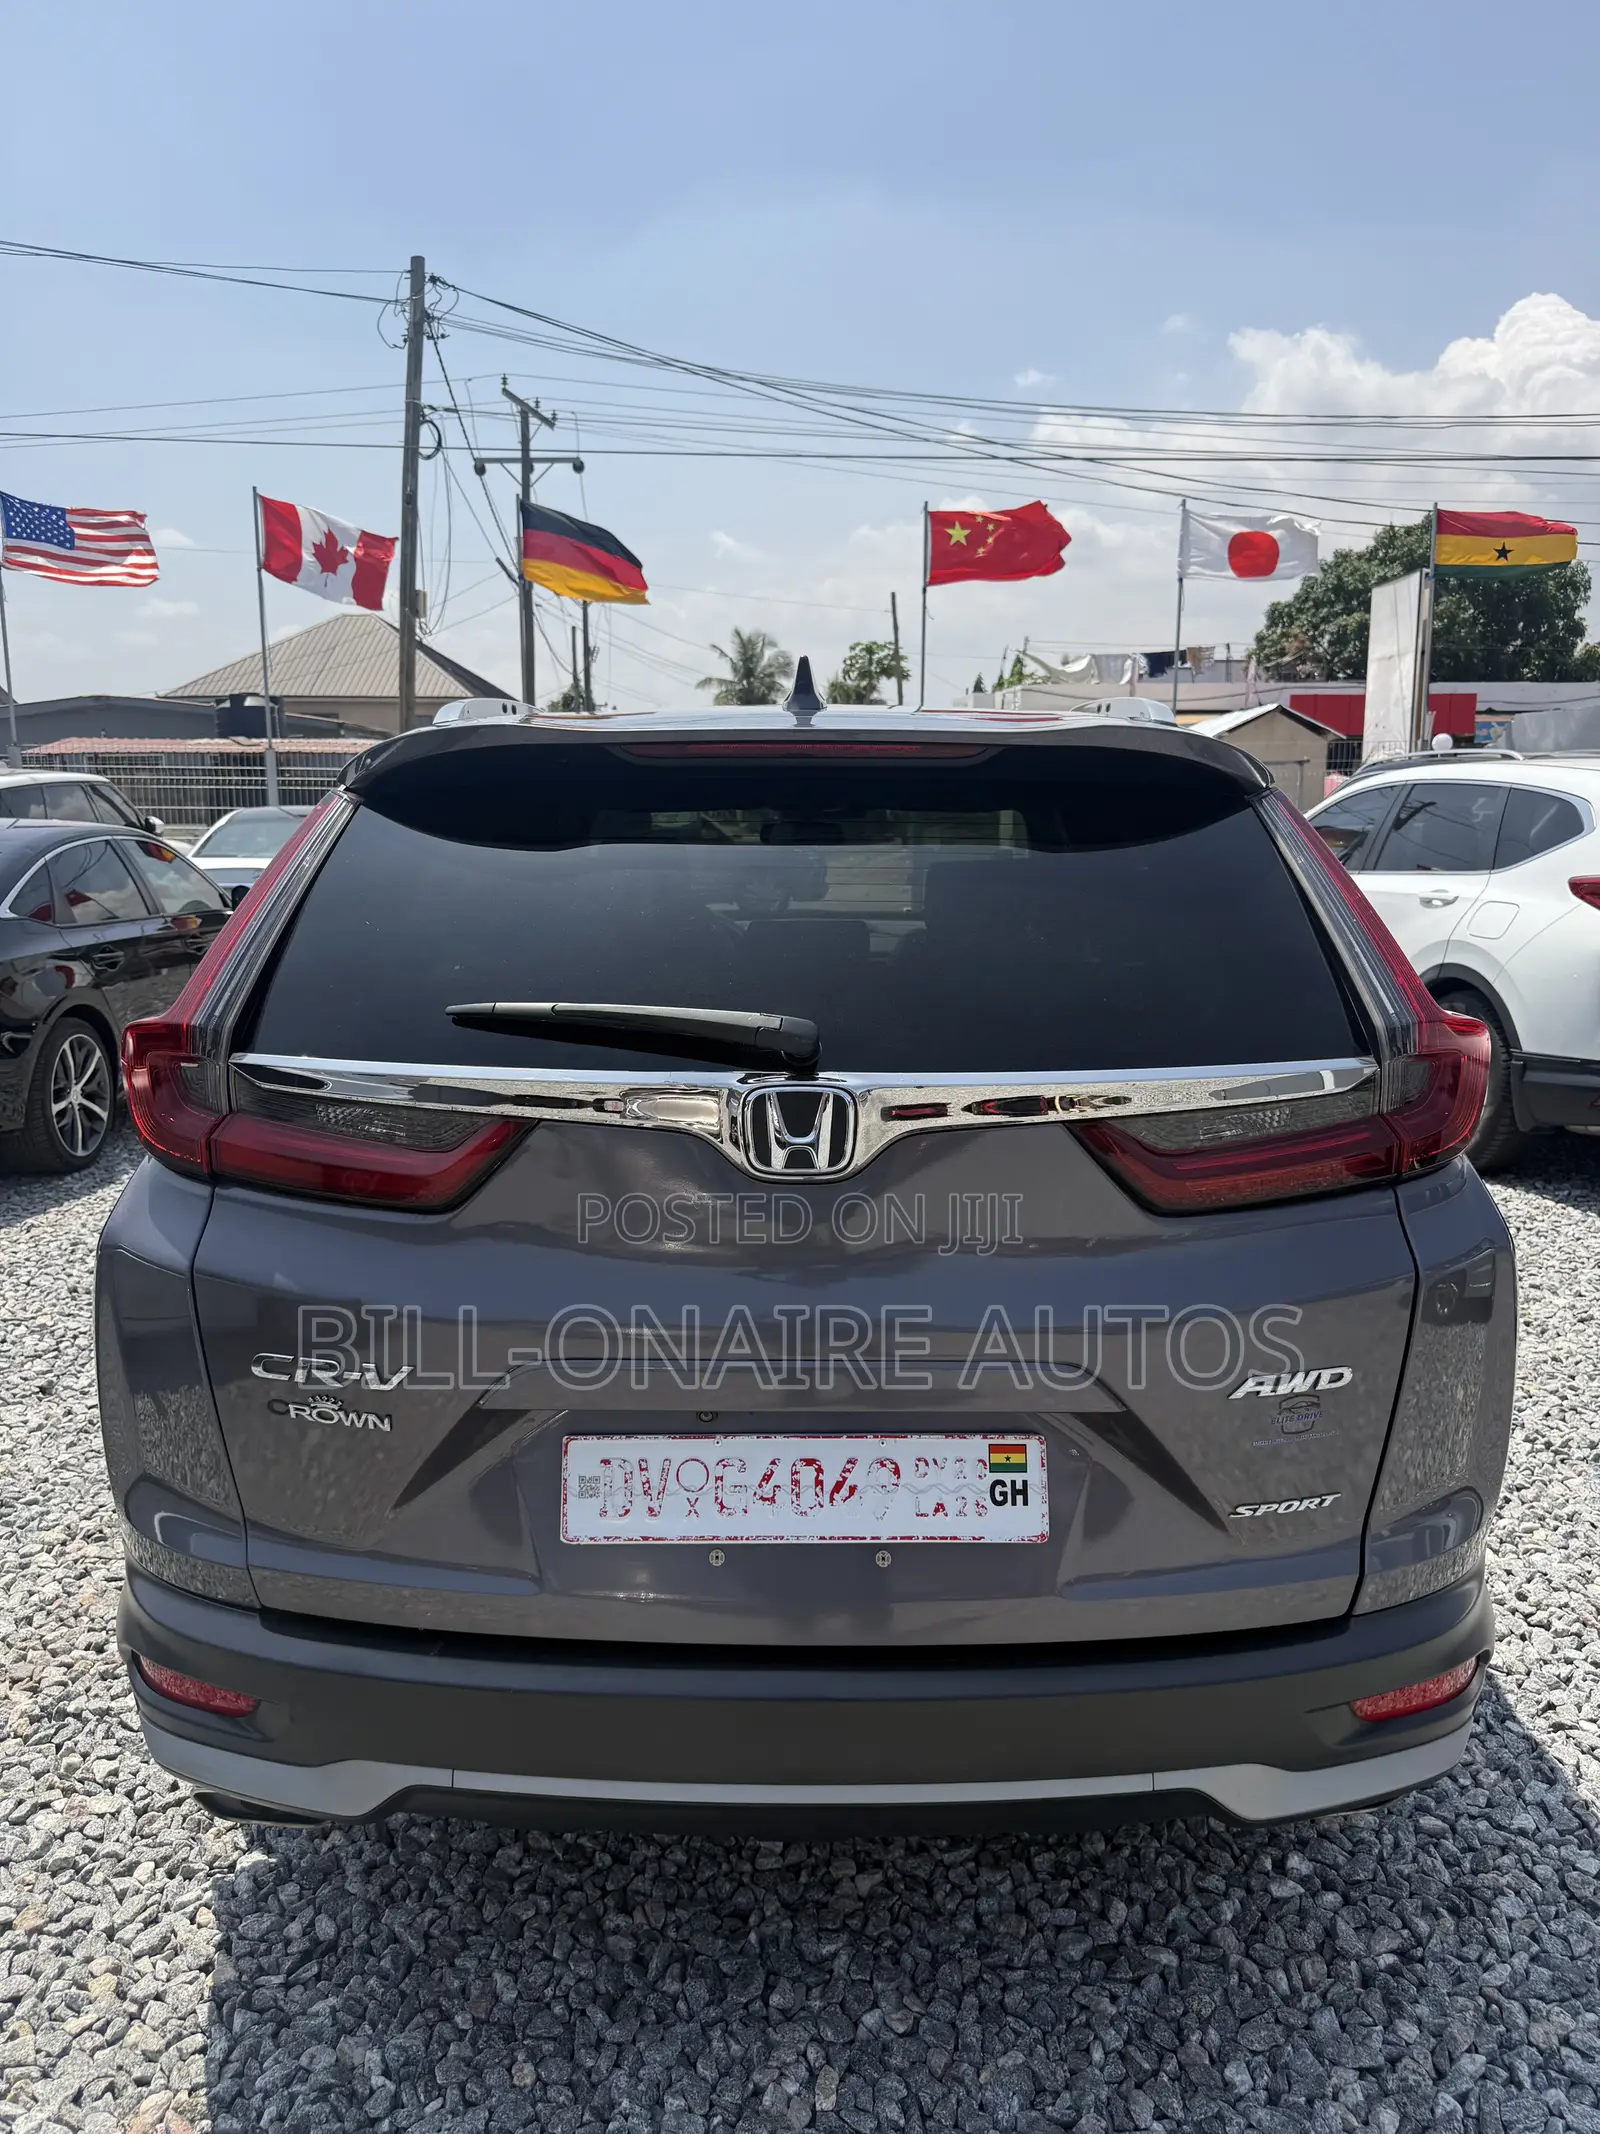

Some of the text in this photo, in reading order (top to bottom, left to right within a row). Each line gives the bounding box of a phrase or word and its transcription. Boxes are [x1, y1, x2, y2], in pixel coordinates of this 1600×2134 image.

[251, 1352, 415, 1390] CR-V
[1228, 1366, 1353, 1400] AWD
[267, 1398, 391, 1432] CROWN
[989, 1479, 1029, 1507] GH
[1229, 1492, 1342, 1518] SPORT
